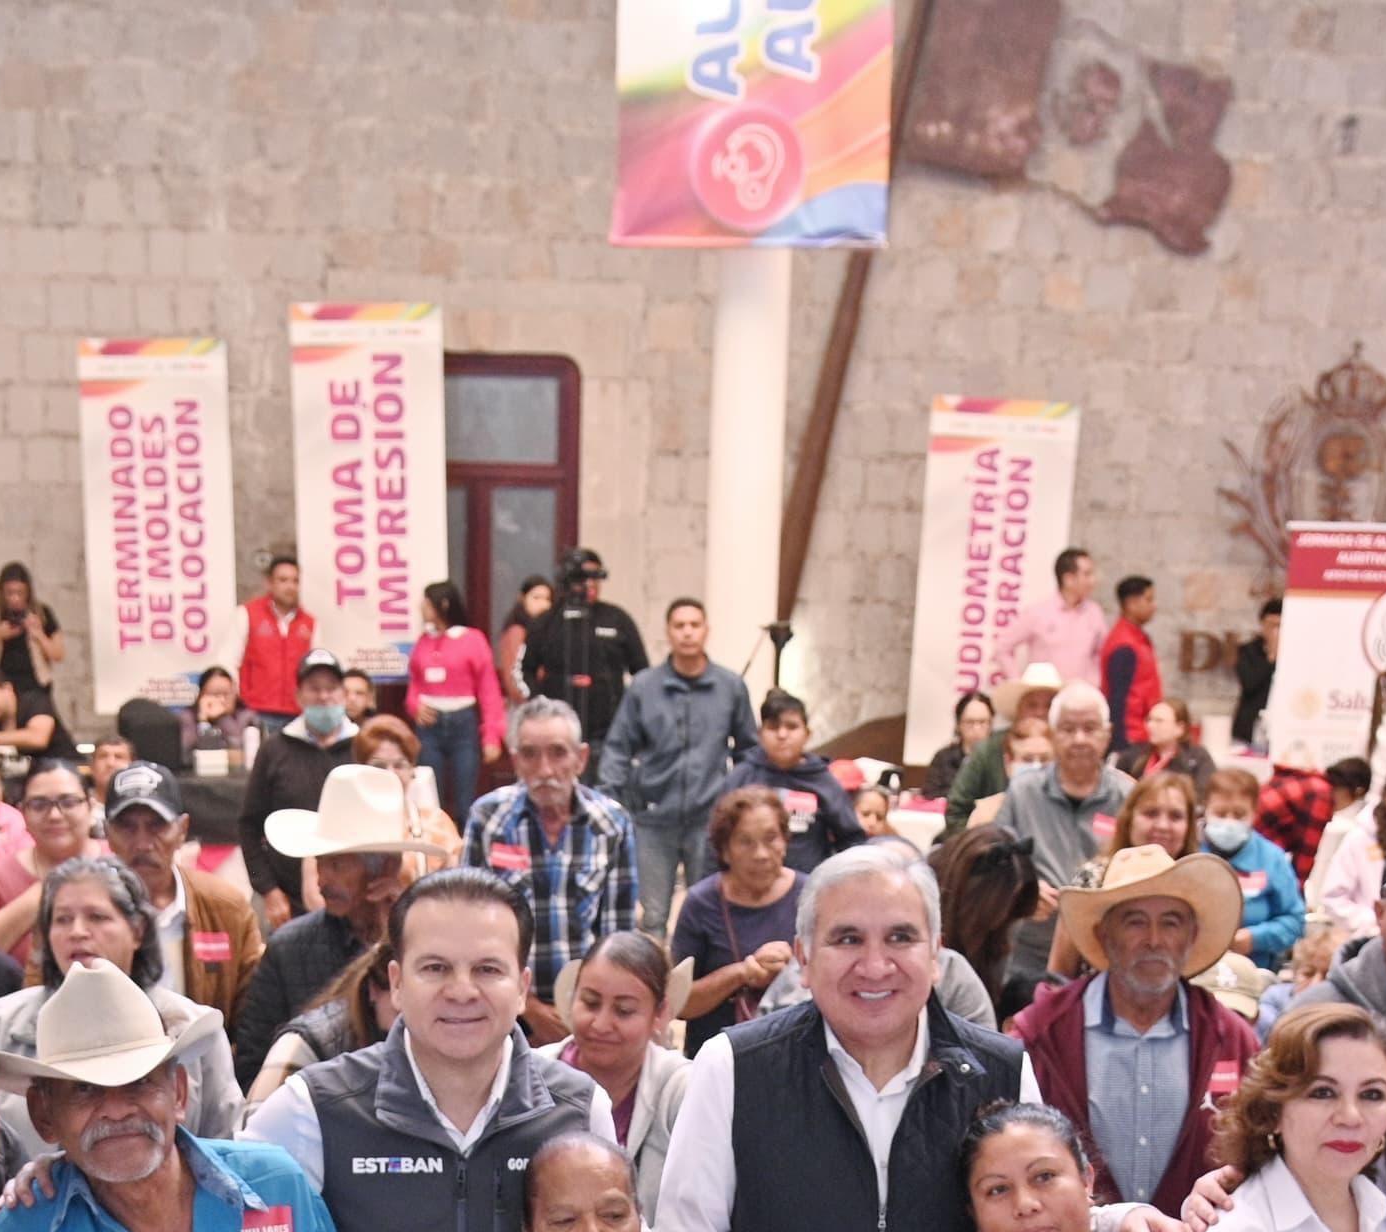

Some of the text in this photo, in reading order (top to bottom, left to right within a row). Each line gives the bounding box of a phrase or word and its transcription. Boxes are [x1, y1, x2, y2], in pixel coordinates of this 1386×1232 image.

[764, 0, 814, 74] A
[108, 404, 142, 651] TERMINADO
[140, 414, 174, 642] DE MOLDES
[328, 379, 366, 606] TOMA DE
[364, 352, 410, 632] IMPRESIÓN
[957, 446, 1001, 695] UDIOMETRÍA
[990, 455, 1033, 688] BRACIÓN
[352, 1156, 444, 1174] ESTEBAN
